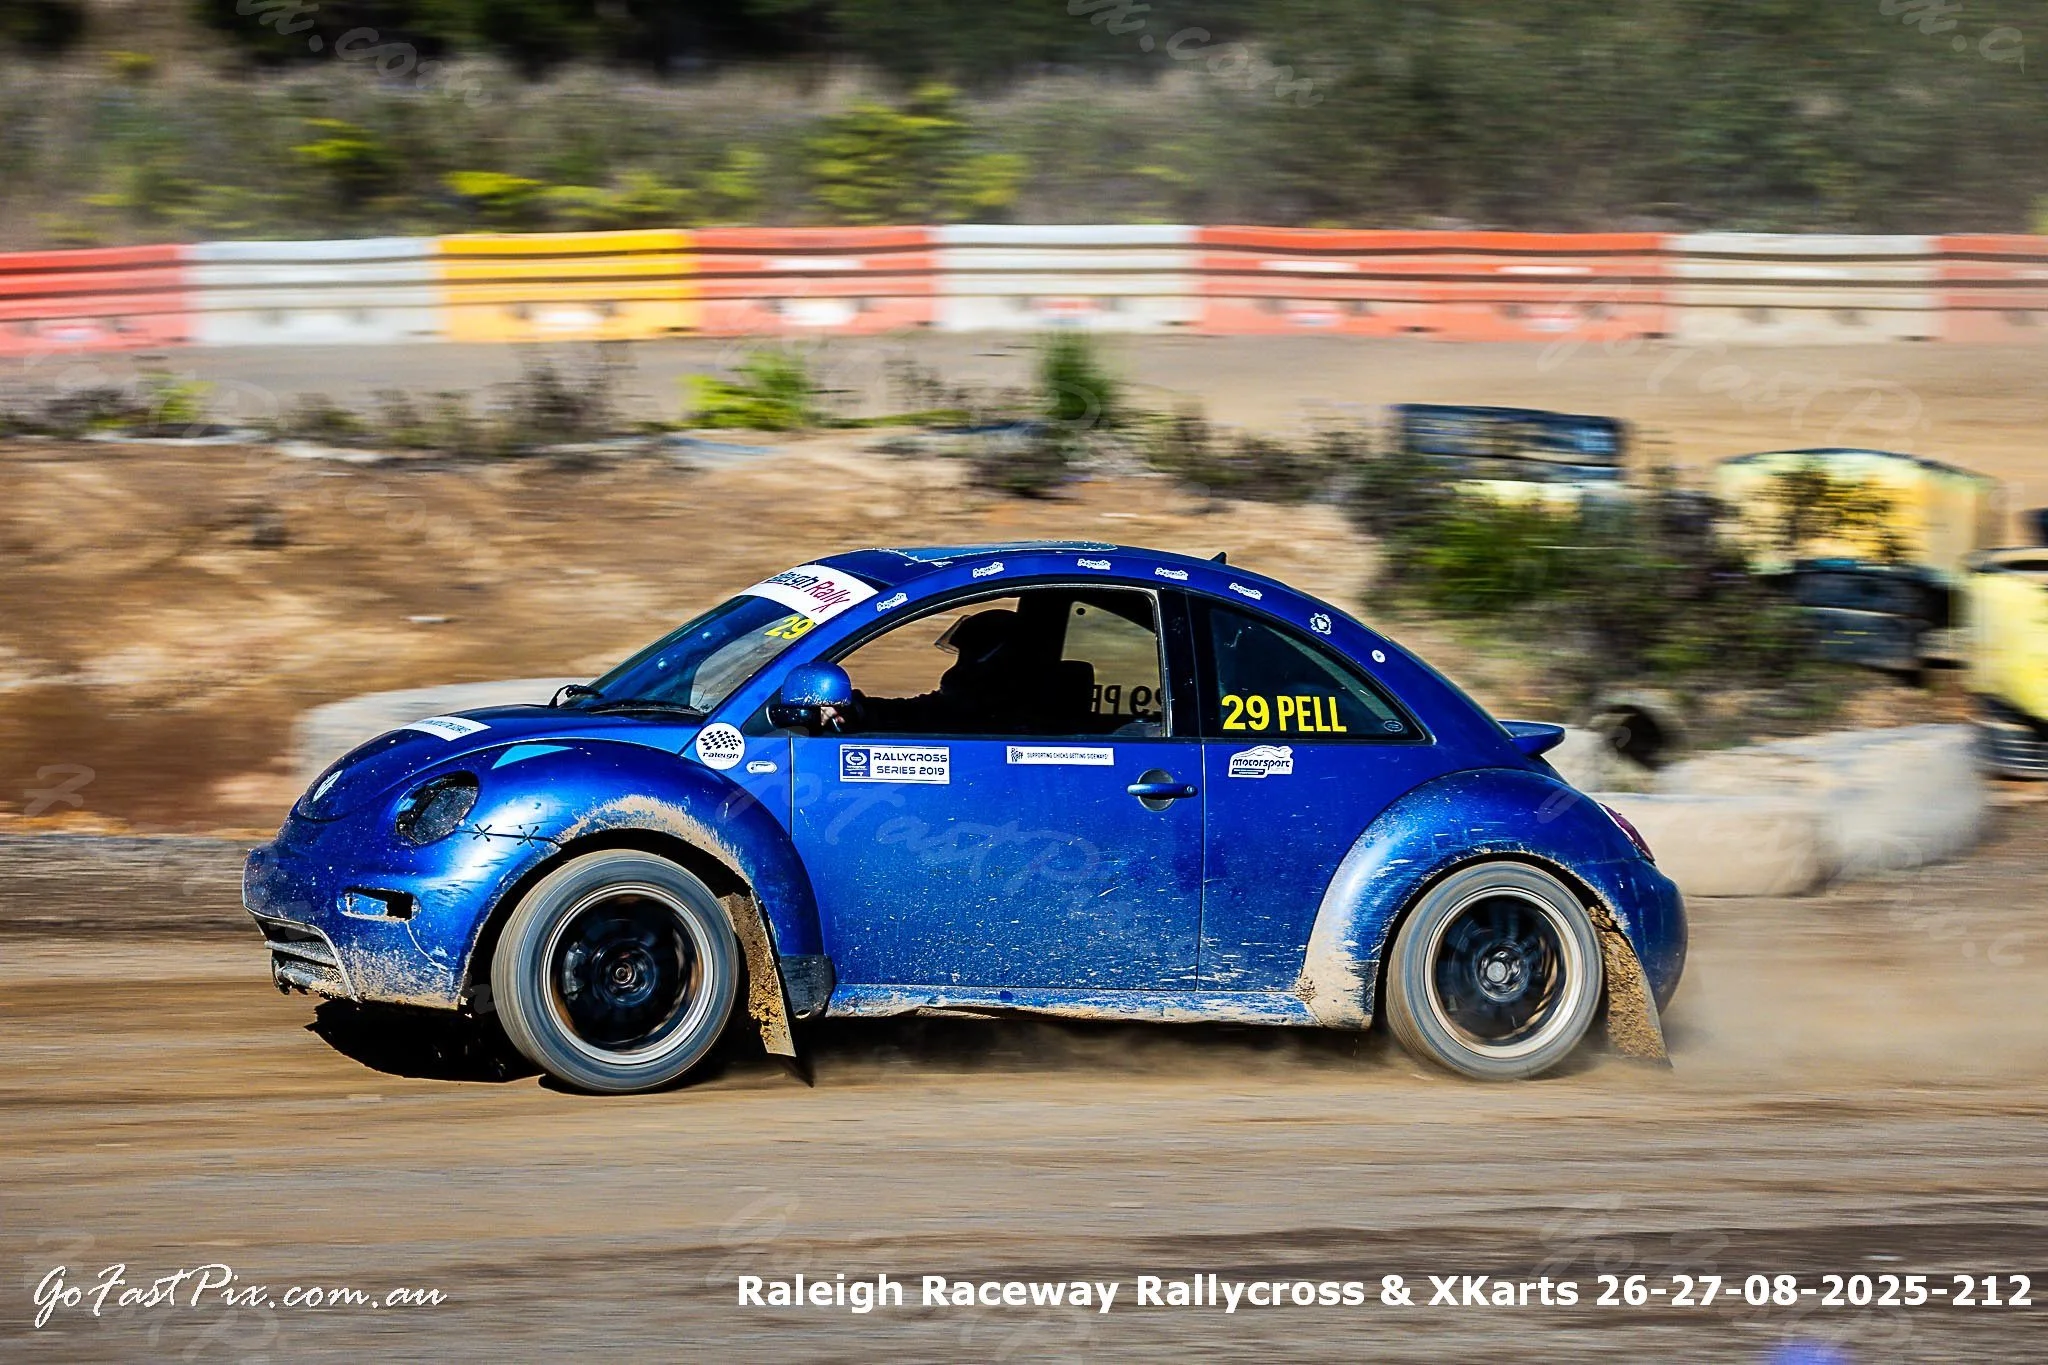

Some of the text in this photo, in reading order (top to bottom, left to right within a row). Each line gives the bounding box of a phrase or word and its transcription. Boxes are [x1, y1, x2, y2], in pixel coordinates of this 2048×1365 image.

[803, 580, 851, 614] Rally
[764, 616, 815, 639] 29
[1221, 694, 1347, 732] 29 PELL
[702, 751, 740, 760] raleigh
[873, 752, 948, 763] RALLYCROSS
[876, 765, 916, 775] SERIES
[919, 766, 945, 776] 2019
[1232, 758, 1291, 771] motorsport
